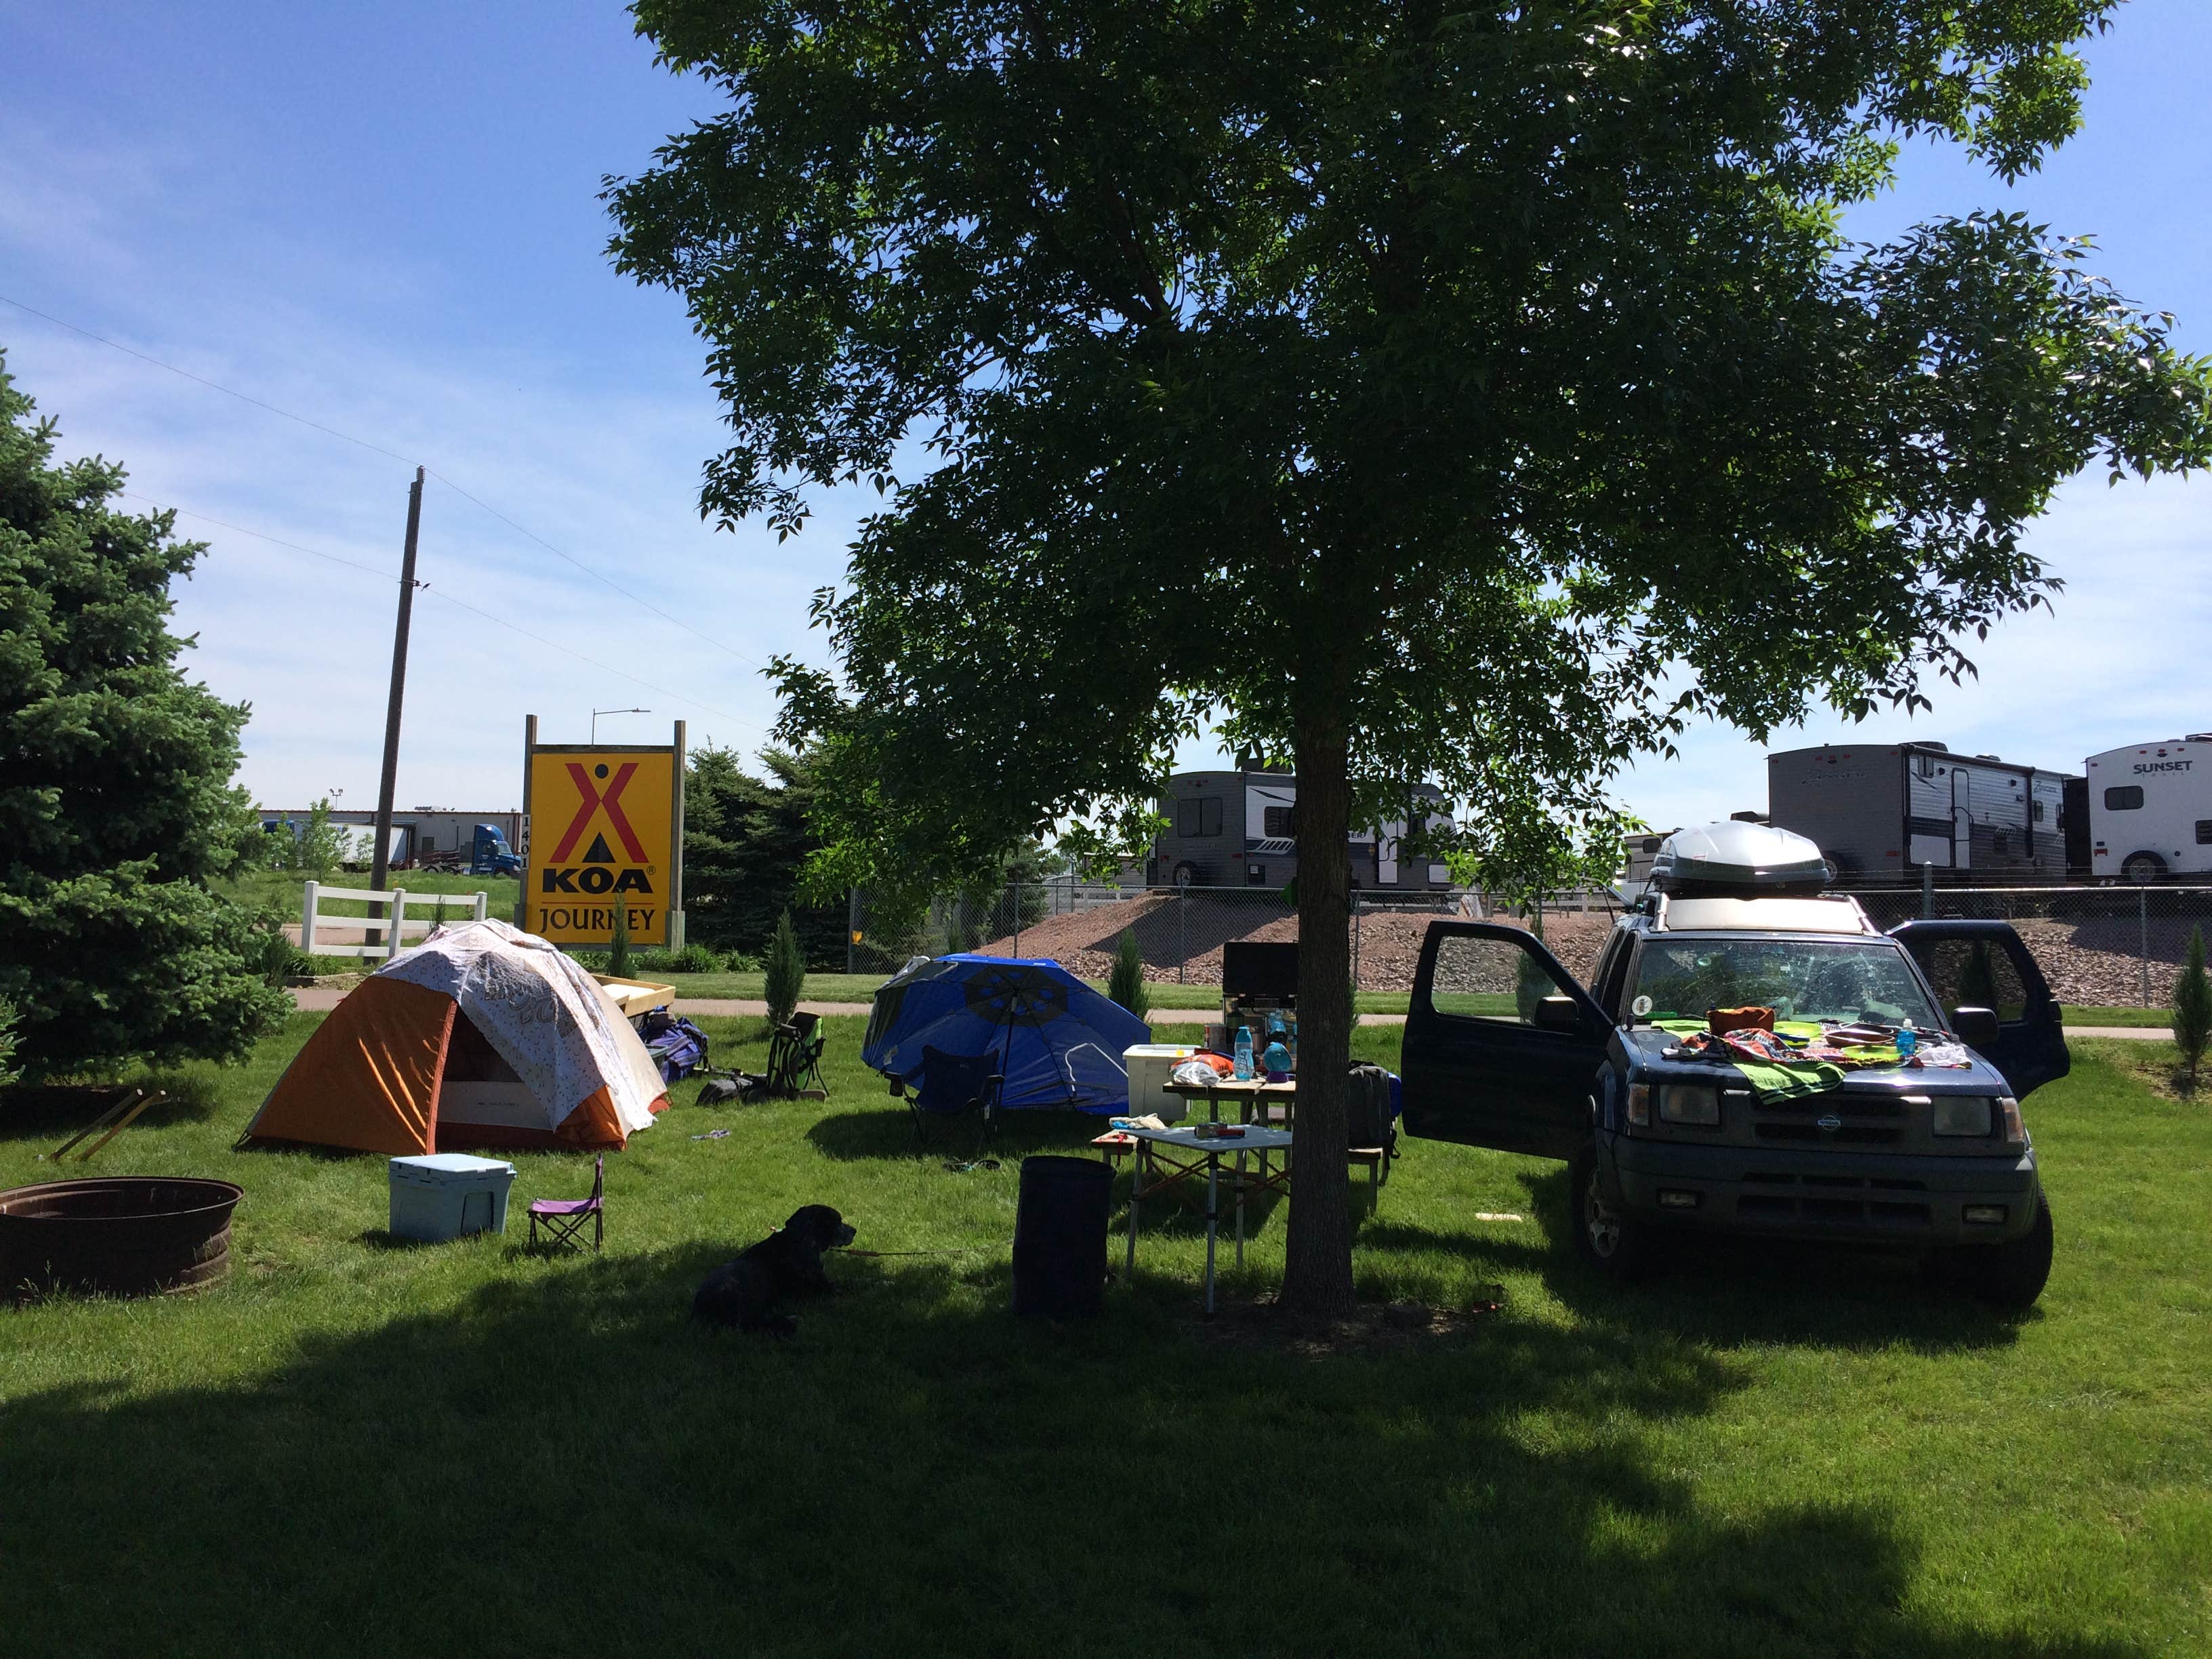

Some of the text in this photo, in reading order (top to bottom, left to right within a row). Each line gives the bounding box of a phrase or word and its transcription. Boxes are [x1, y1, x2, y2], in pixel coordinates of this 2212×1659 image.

[2133, 760, 2193, 775] SUNSET
[520, 816, 529, 868] 1401
[542, 866, 653, 895] KOA
